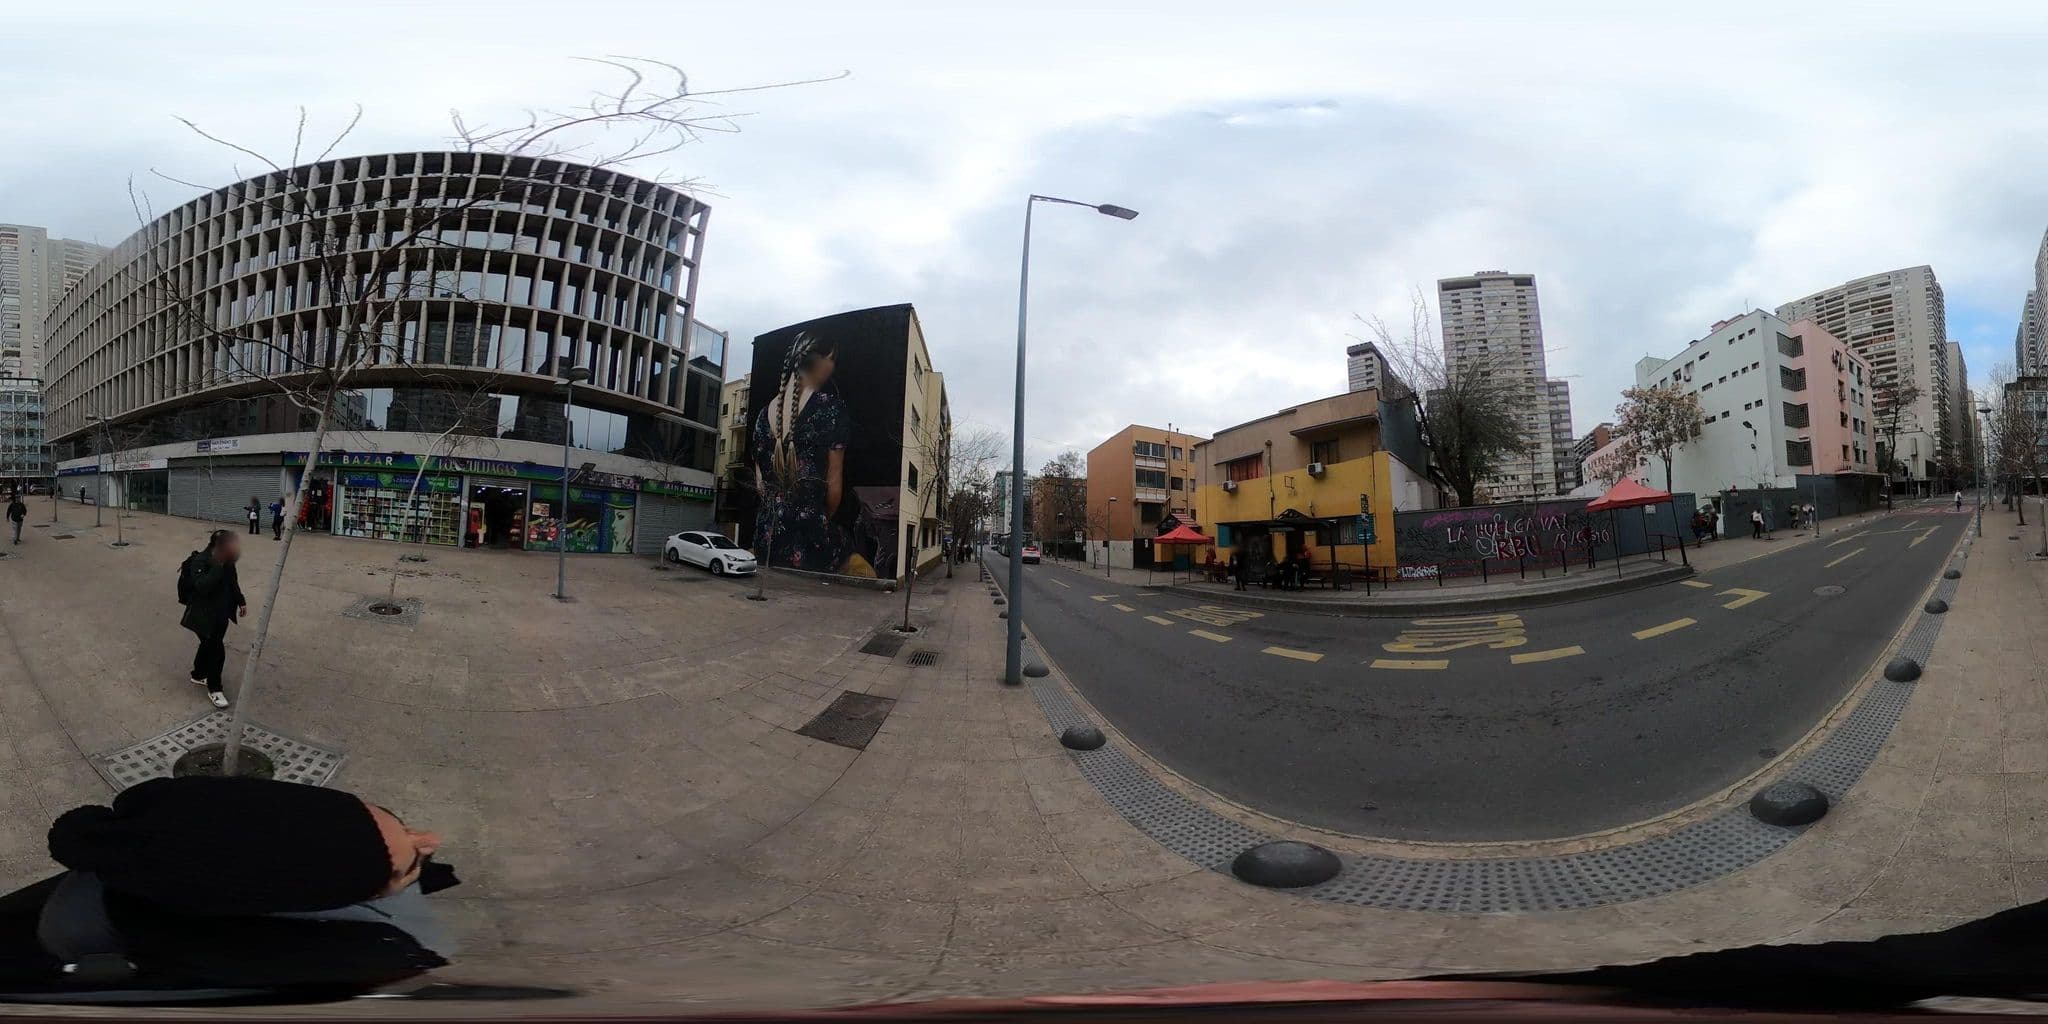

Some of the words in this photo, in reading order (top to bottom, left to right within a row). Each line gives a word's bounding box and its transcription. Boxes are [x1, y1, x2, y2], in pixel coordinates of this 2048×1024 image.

[298, 455, 334, 464] MLL
[342, 455, 393, 466] BAZAR
[664, 482, 712, 497] MINIMARKET
[1447, 526, 1469, 543] LA
